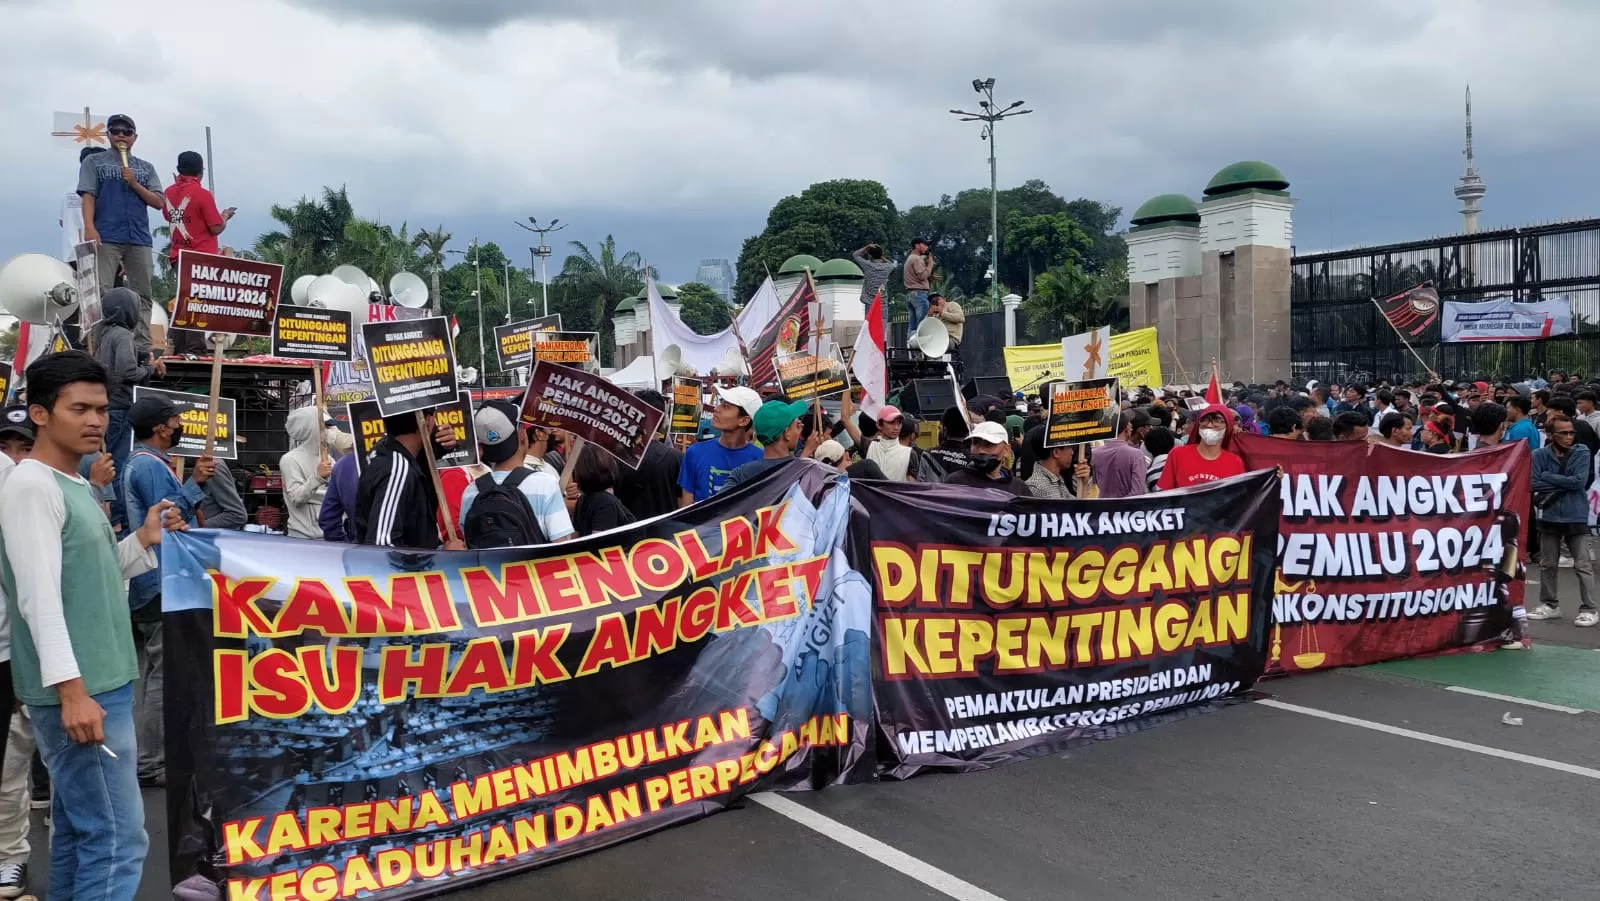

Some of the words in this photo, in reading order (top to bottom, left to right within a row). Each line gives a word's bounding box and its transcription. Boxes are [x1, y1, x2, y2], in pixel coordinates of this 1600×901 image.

[190, 282, 236, 302] PEMILU
[237, 288, 267, 306] 2024
[191, 264, 219, 282] HAK
[220, 268, 272, 288] ANGKET
[187, 302, 265, 319] INKONSTITUSIONAL
[279, 317, 346, 333] DITUNGGANGI
[279, 329, 346, 344] KEPENTINGAN
[371, 339, 445, 363] DITUNGGANGI
[502, 342, 531, 355] KEPENT
[376, 357, 449, 383] KEPENTINGAN
[542, 387, 602, 415] PEMILU
[601, 408, 638, 437] 2024
[547, 373, 585, 394] HAK
[584, 385, 646, 423] ANGKET
[538, 402, 632, 448] INKONSTITUSIONAL
[1351, 472, 1508, 517] ANGKET
[987, 512, 1037, 537] ISU
[1040, 511, 1094, 538] HAK
[1098, 507, 1185, 535] ANGKET
[207, 569, 463, 638] KAMI
[458, 499, 799, 628] MENOLAK
[871, 532, 1252, 608] DITUNGGANGI
[1277, 531, 1406, 577] EMILU
[1412, 524, 1505, 573] 2024
[1270, 580, 1498, 624] NKONSTITUSIONAL
[213, 645, 363, 725] ISU
[378, 624, 571, 704] HAK
[575, 554, 829, 678] ANGKET
[882, 591, 1251, 676] KEPENTINGAN
[944, 684, 1084, 719] PEMAKZULAN
[1086, 669, 1171, 703] PRESIDEN
[1174, 663, 1212, 687] DAN
[222, 789, 449, 866] KARENA
[451, 706, 750, 820] MENIMBULKAN
[227, 811, 548, 901] KEGADUHAN
[553, 783, 641, 843] DAN
